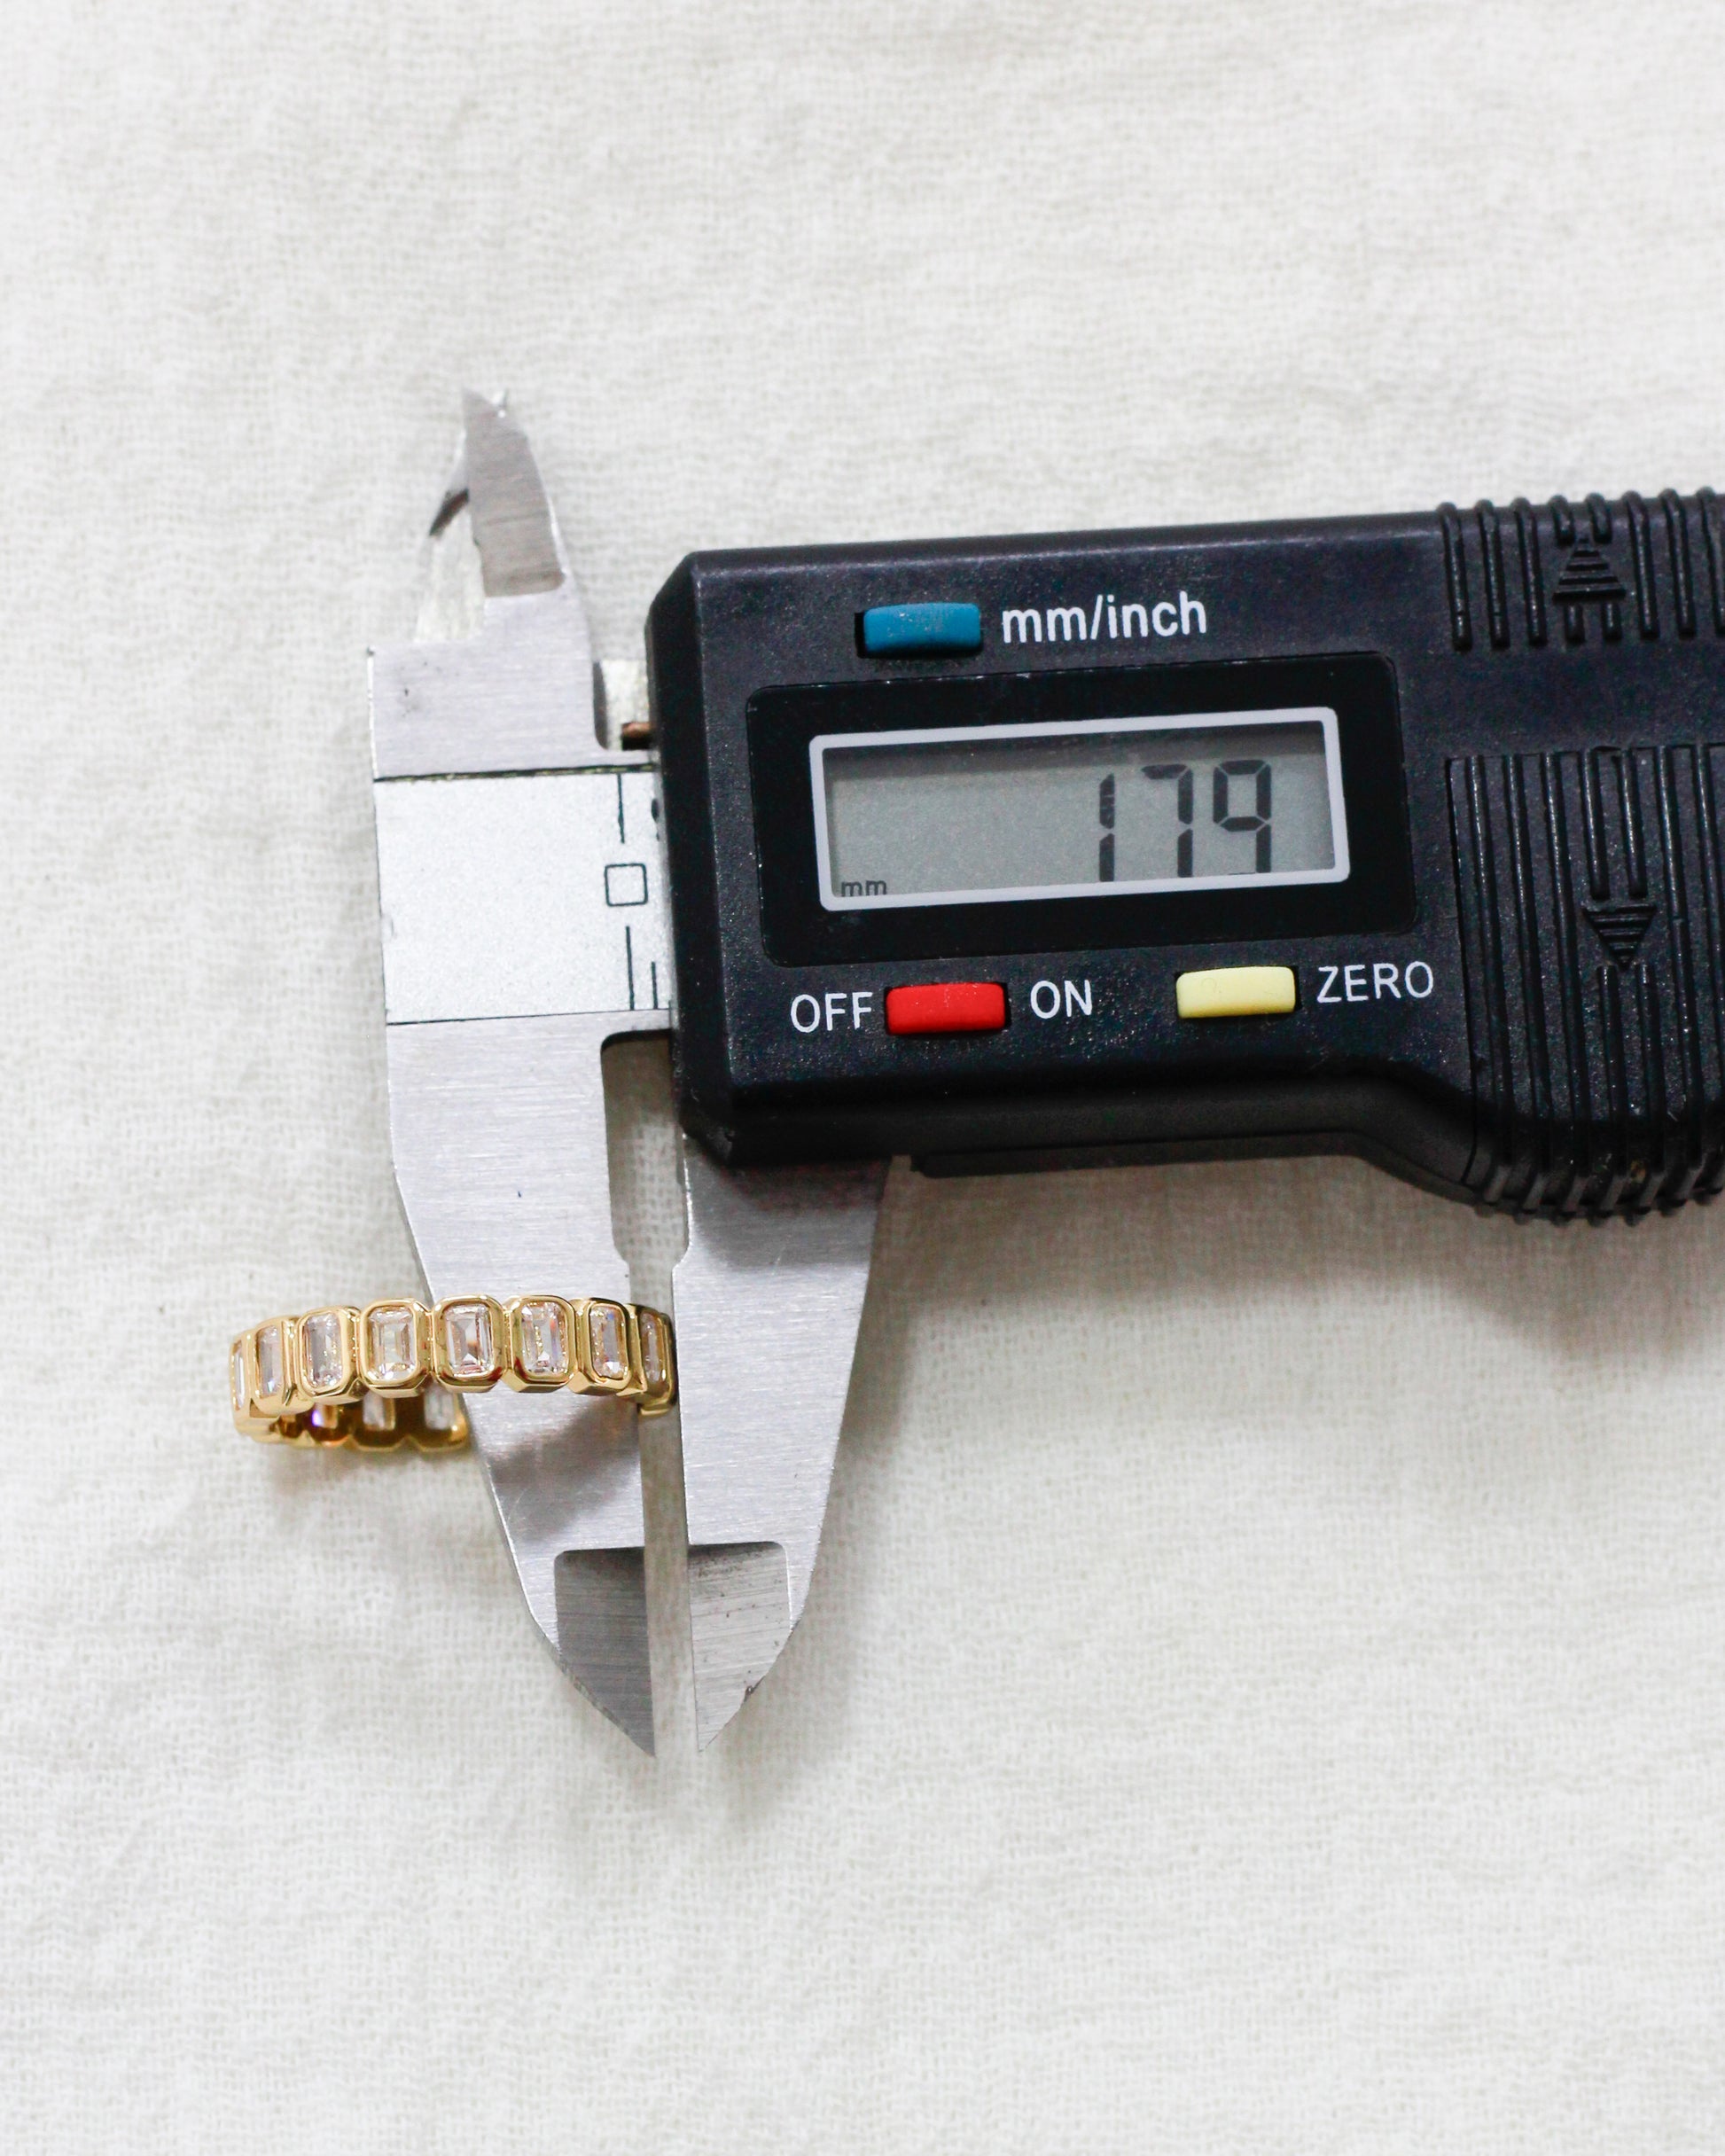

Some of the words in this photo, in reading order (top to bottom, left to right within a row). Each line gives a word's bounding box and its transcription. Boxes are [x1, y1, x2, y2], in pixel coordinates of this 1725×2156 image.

[1001, 590, 1208, 644] mm/inch
[840, 879, 887, 897] mm
[1029, 979, 1093, 1019] ON
[1316, 960, 1434, 1004] ZERO
[790, 991, 874, 1034] OFF
